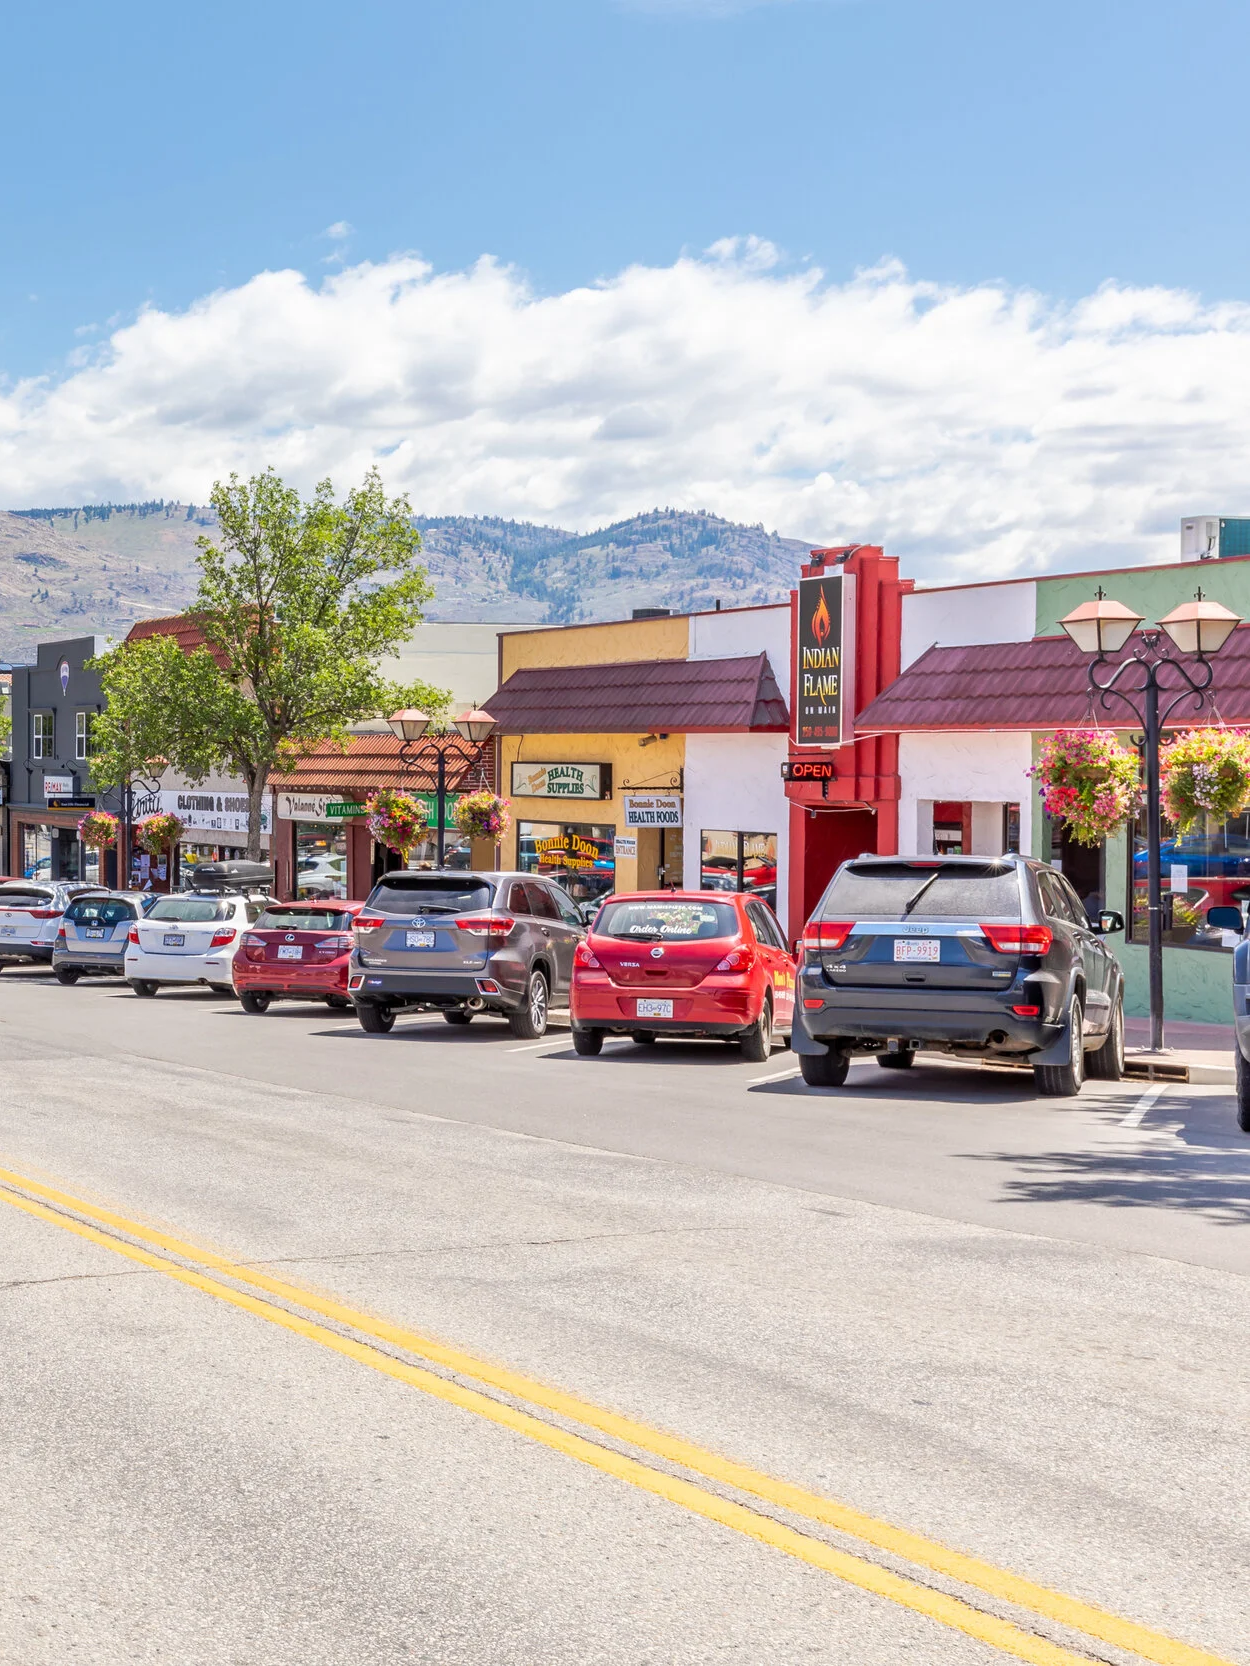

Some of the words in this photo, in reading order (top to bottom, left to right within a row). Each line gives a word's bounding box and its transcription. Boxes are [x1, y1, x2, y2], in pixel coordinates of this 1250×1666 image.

[803, 646, 840, 669] INDIAN
[803, 673, 838, 706] FLAME
[547, 766, 584, 782] HEALTH
[792, 763, 832, 777] OPEN
[547, 782, 585, 794] SUPPLIES
[177, 794, 214, 811] CLOTHING
[216, 796, 223, 812] &
[629, 798, 655, 809] Bonnie
[655, 798, 677, 809] Doon
[628, 810, 656, 823] HEALTH
[656, 810, 679, 823] FOODS
[534, 832, 570, 854] Bonnie
[572, 834, 599, 860] Doon
[615, 845, 636, 856] ENTRANCE
[539, 853, 562, 865] Health
[562, 855, 593, 869] Supplies
[630, 925, 658, 934] Order
[660, 925, 692, 935] Online
[902, 925, 929, 934] Jeep
[895, 945, 939, 957] BFP-9919
